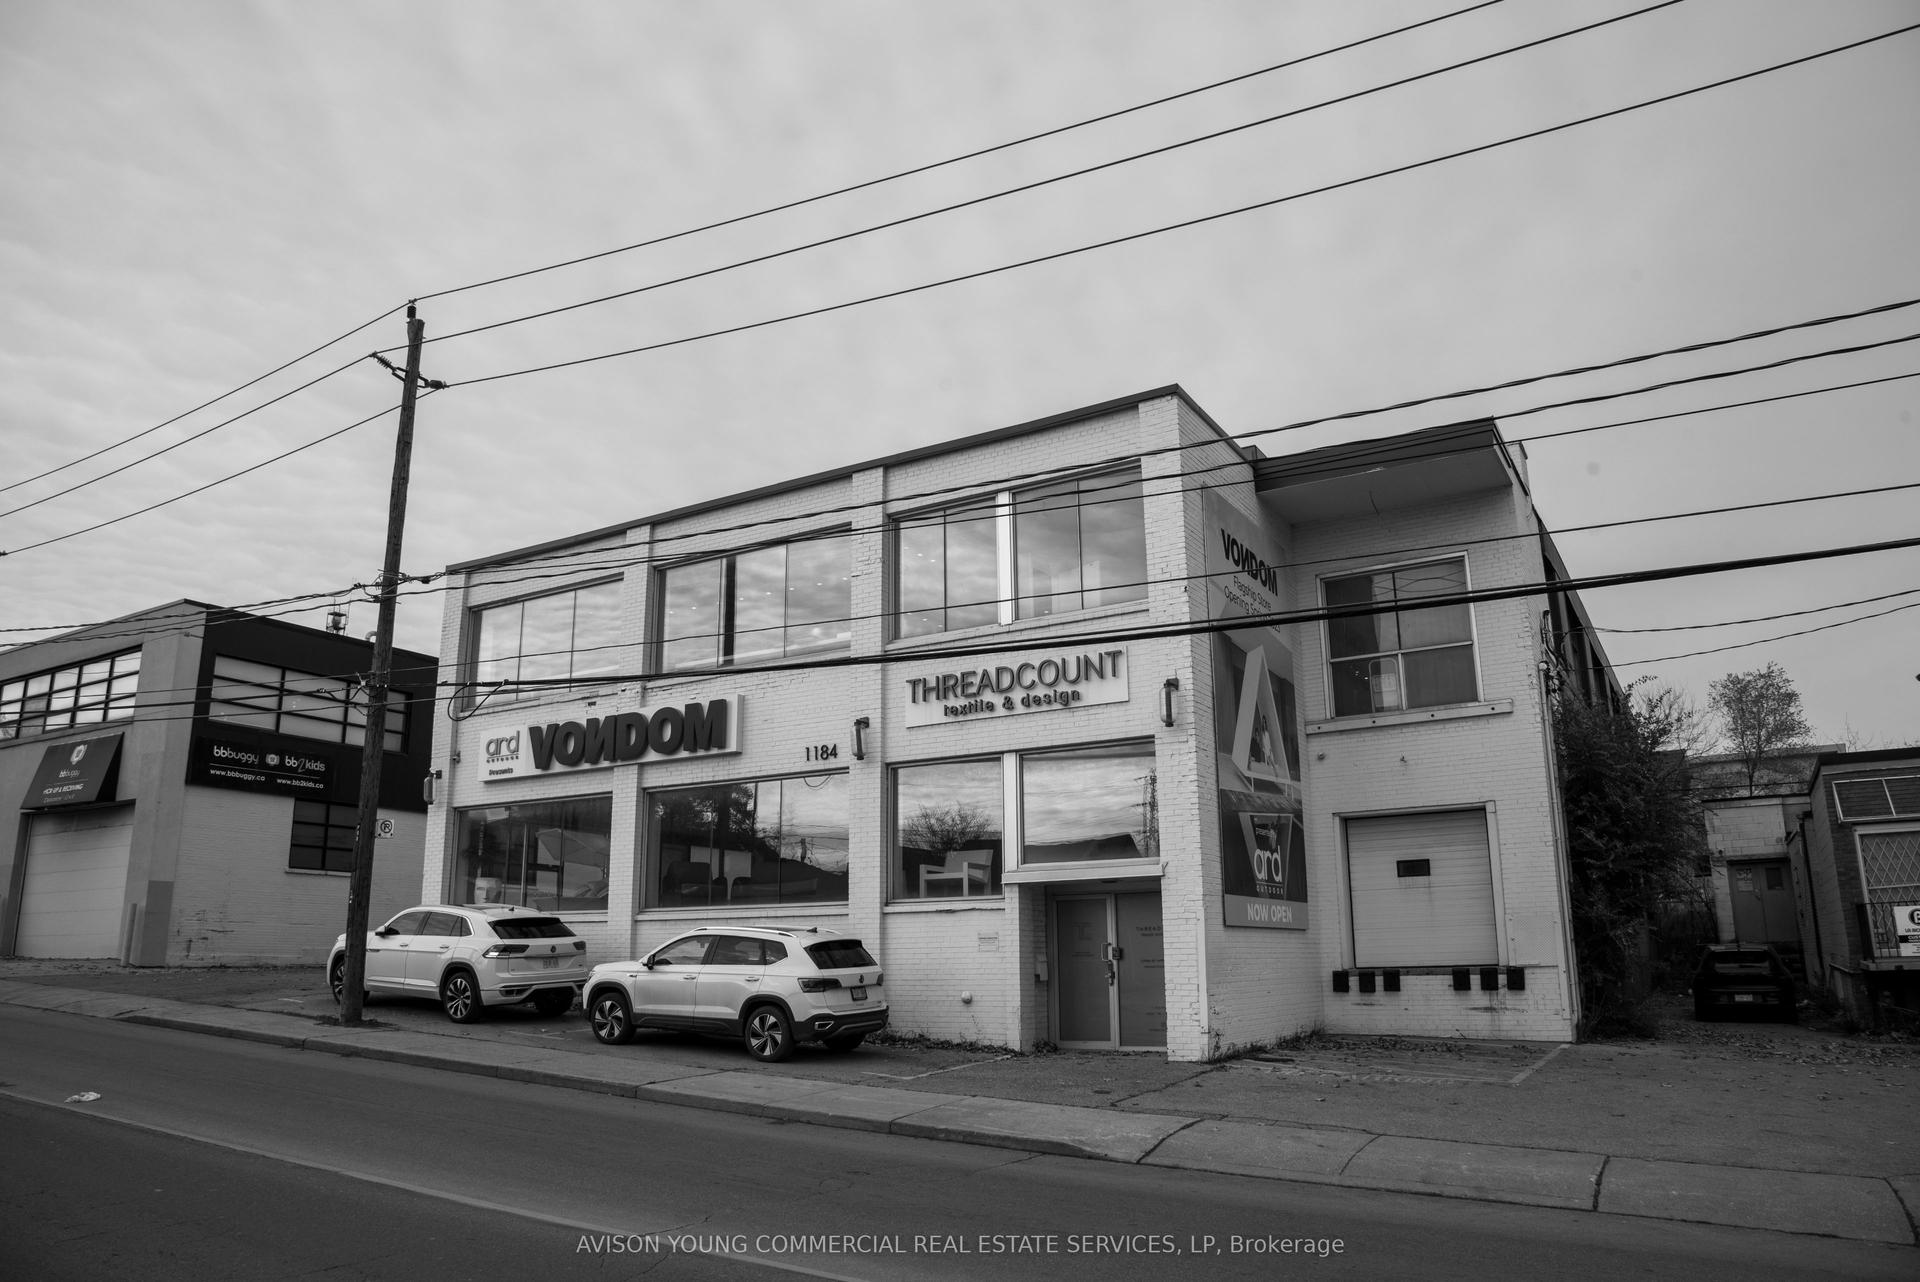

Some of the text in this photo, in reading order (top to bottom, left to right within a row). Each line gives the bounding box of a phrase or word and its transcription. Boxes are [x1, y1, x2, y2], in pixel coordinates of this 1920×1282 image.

[1224, 586, 1250, 615] Opening
[905, 650, 1122, 703] THREADCOUNT
[943, 689, 1081, 716] textile & design
[486, 730, 520, 756] ard
[805, 743, 838, 761] 1184
[213, 745, 259, 765] bbbuggy
[285, 755, 326, 773] bb2kids
[210, 769, 266, 781] www.bbbuggy.co
[277, 778, 324, 789] www.bb2kids.co
[1254, 845, 1282, 882] ard
[1247, 903, 1293, 923] NOW OPEN
